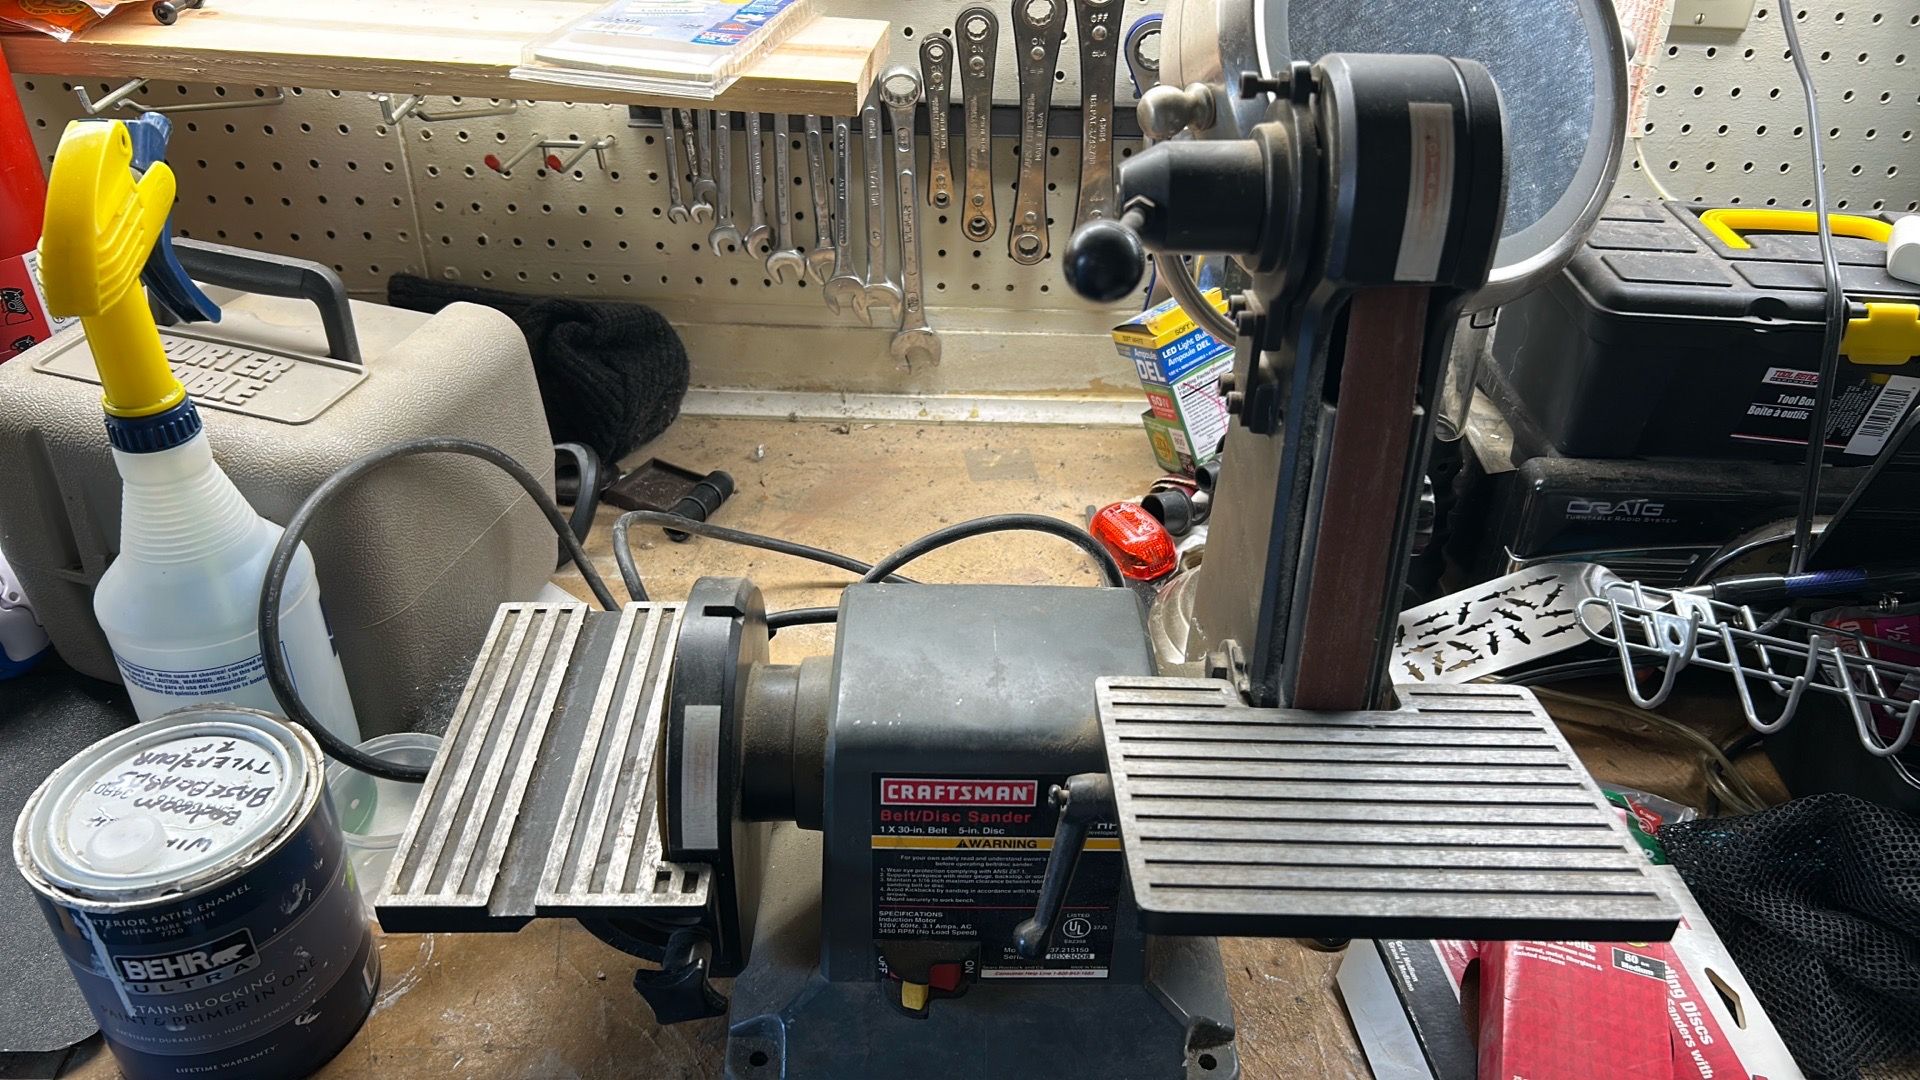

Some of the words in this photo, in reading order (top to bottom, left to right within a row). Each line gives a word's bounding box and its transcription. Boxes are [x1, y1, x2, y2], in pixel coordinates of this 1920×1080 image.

[1162, 347, 1177, 359] LED
[1178, 337, 1195, 353] Light
[1168, 349, 1196, 366] Ampoule
[1196, 340, 1211, 352] DEL
[1136, 359, 1166, 382] DEL
[171, 366, 267, 406] ABLE
[1777, 394, 1799, 405] Tool
[1798, 396, 1816, 406] Box
[1773, 407, 1781, 417] à
[1780, 411, 1809, 420] outils
[1567, 499, 1664, 516] CRAIG
[888, 784, 1028, 801] CRAFTSMAN
[880, 809, 961, 823] Belt/Disc
[968, 810, 1032, 823] Sander
[898, 826, 925, 834] 30-in.
[958, 827, 980, 835] 5-in.
[983, 827, 1005, 835] Disc
[970, 839, 1037, 849] WARNING
[92, 917, 148, 929] NTERIOR
[152, 908, 193, 924] SATIN
[198, 883, 250, 911] ENAMEL
[122, 928, 152, 936] ULTRA
[156, 922, 180, 932] PURE
[184, 911, 216, 926] WHITE
[122, 951, 213, 981] BEHR
[965, 960, 974, 974] ON
[1403, 957, 1418, 982] Medium
[1621, 961, 1654, 976] Medium
[1624, 953, 1639, 965] 80
[133, 963, 250, 993] ULTRA
[1398, 964, 1415, 992] Mediano
[172, 1001, 248, 1027] PRIMER
[255, 986, 276, 1003] IN
[282, 958, 318, 988] ONE
[1665, 964, 1687, 999] ding
[1680, 1001, 1714, 1046] Discs
[176, 1064, 218, 1074] LIFETIME
[222, 1045, 276, 1070] WARRANTY
[1691, 1050, 1714, 1080] with
